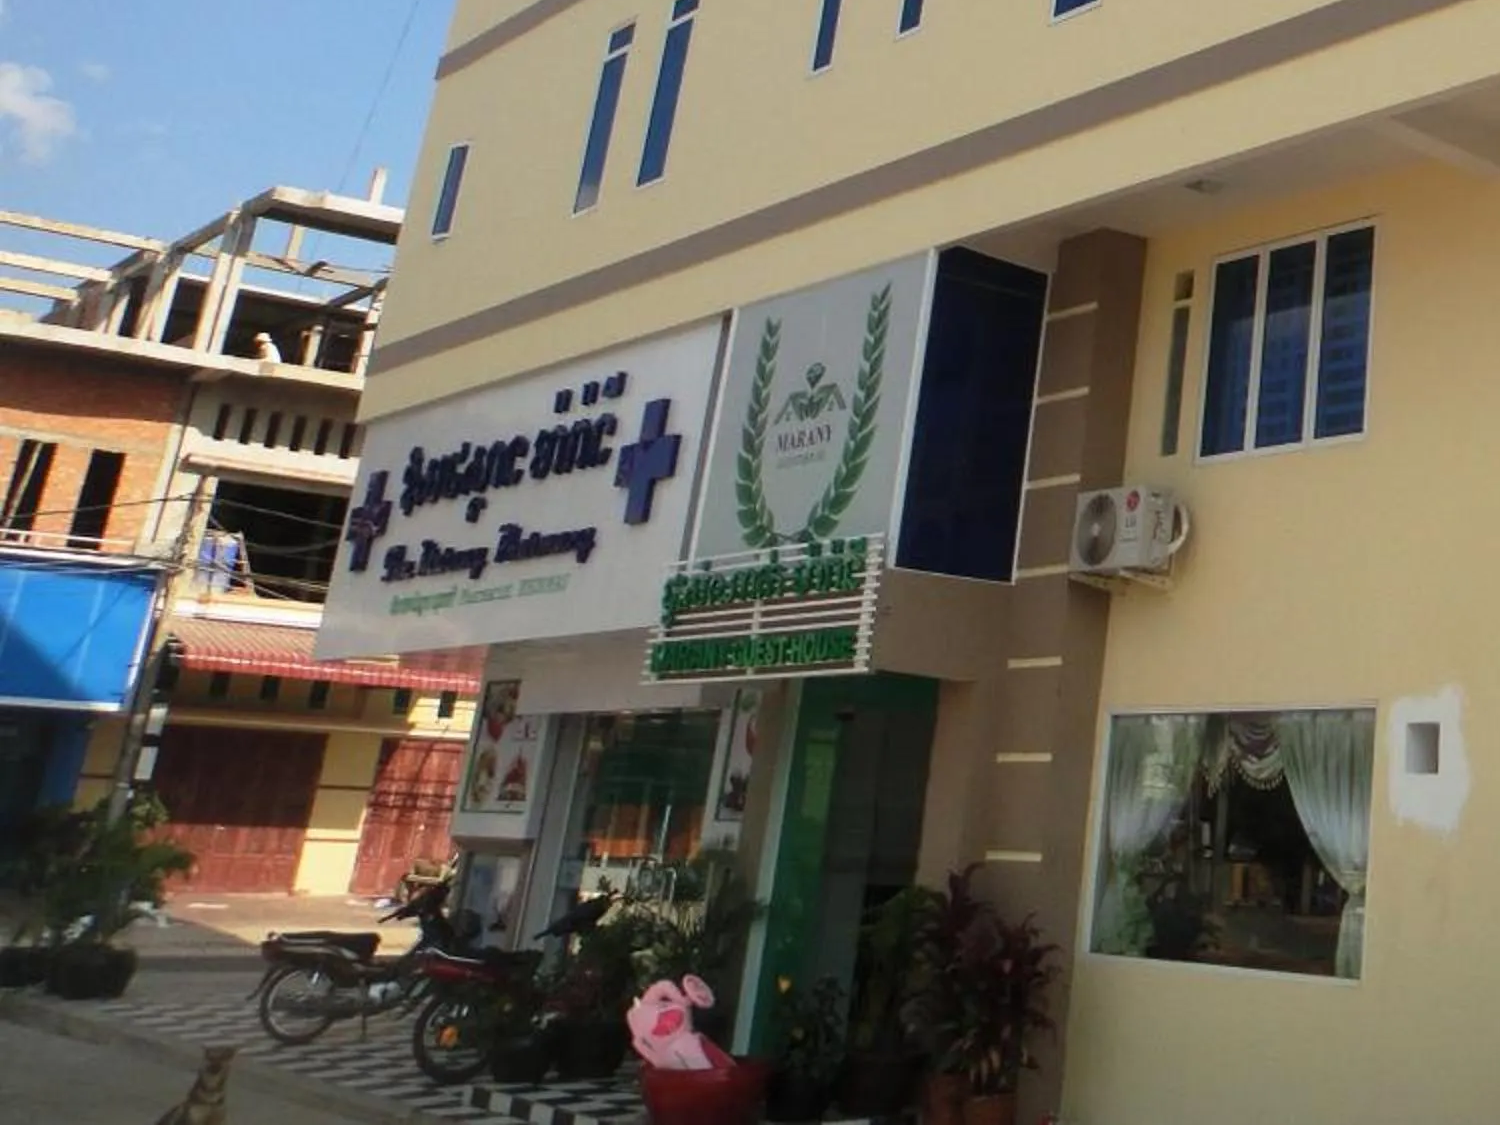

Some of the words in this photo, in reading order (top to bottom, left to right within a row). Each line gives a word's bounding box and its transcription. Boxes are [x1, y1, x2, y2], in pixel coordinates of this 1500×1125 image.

[775, 424, 832, 452] MARANY
[735, 635, 788, 668] GUEST
[792, 627, 855, 664] HOUSE
